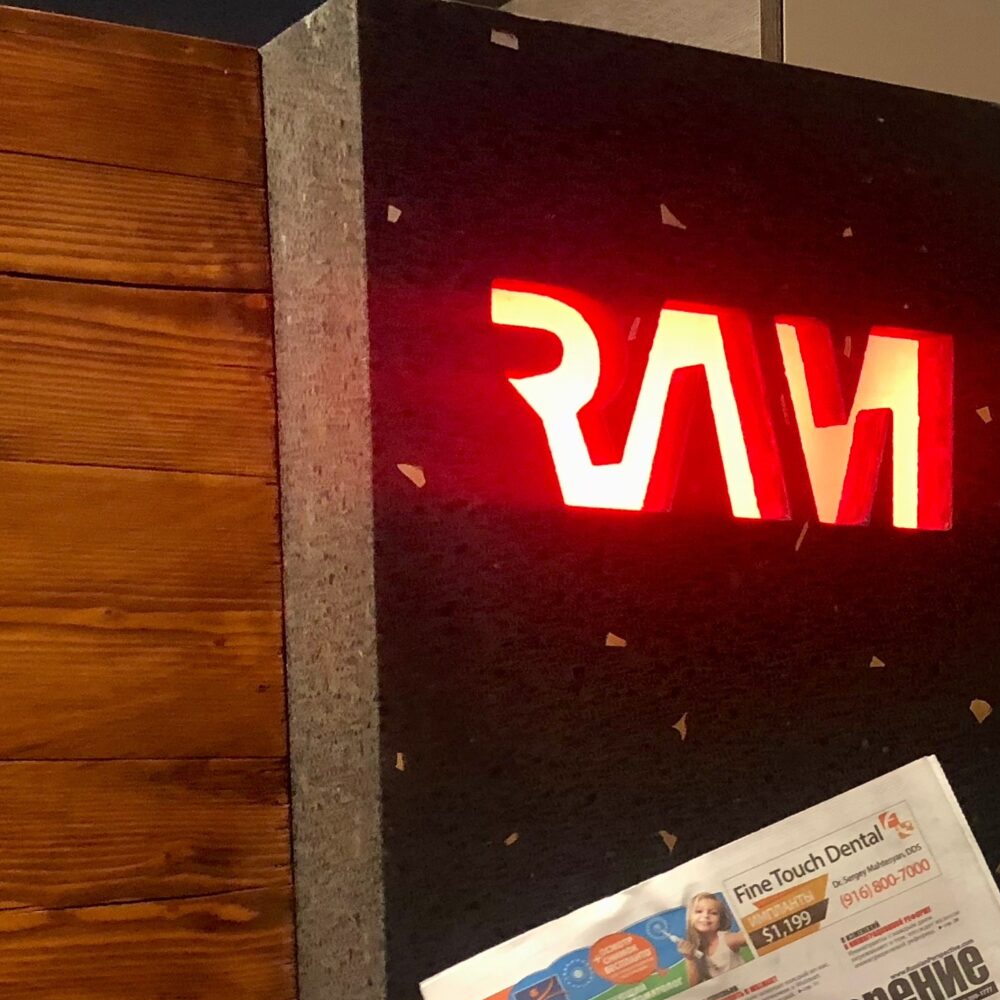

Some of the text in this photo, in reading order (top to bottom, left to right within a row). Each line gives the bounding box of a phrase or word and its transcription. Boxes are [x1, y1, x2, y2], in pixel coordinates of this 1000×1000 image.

[732, 823, 884, 905] Fine Touch Dental
[838, 856, 932, 910] (916) 800-7000
[842, 867, 867, 884] Sergey
[904, 841, 923, 857] DDS
[747, 887, 815, 929] ИМПЛАНТЫ
[760, 908, 814, 944] $1,199
